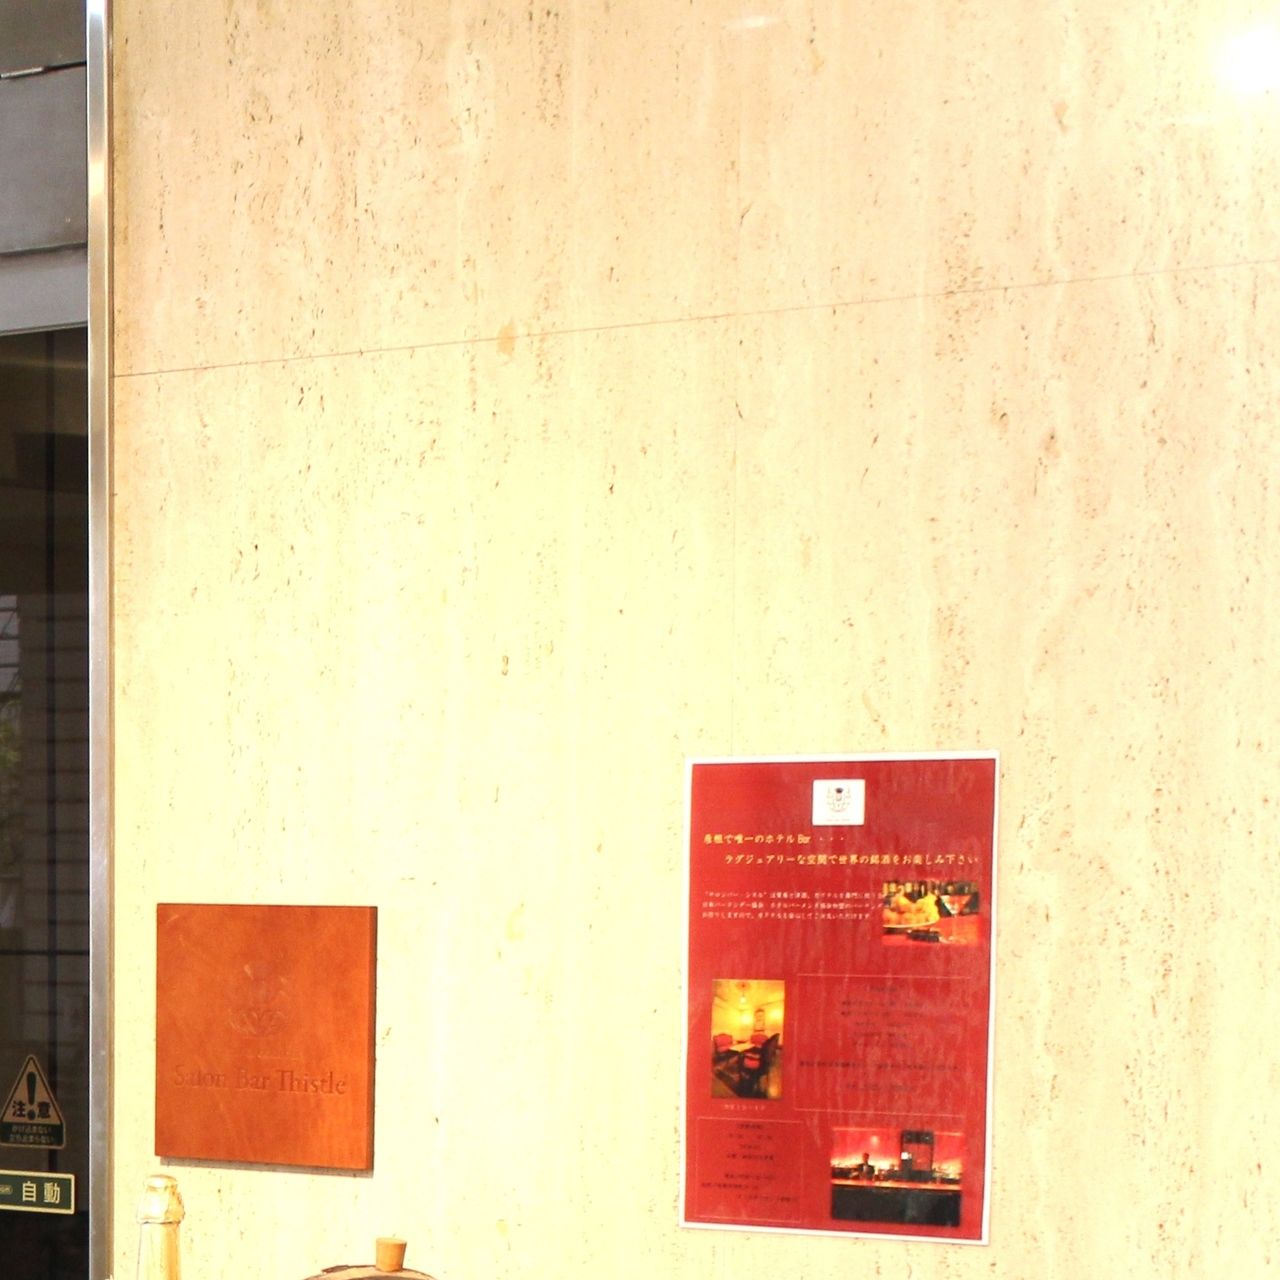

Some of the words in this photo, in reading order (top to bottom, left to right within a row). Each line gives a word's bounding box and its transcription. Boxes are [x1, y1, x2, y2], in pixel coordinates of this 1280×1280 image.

[174, 1064, 226, 1089] Salon
[235, 1067, 271, 1091] Bar
[275, 1069, 347, 1095] Thistle
[11, 1100, 51, 1119] 注意
[22, 1180, 61, 1204] 自動
